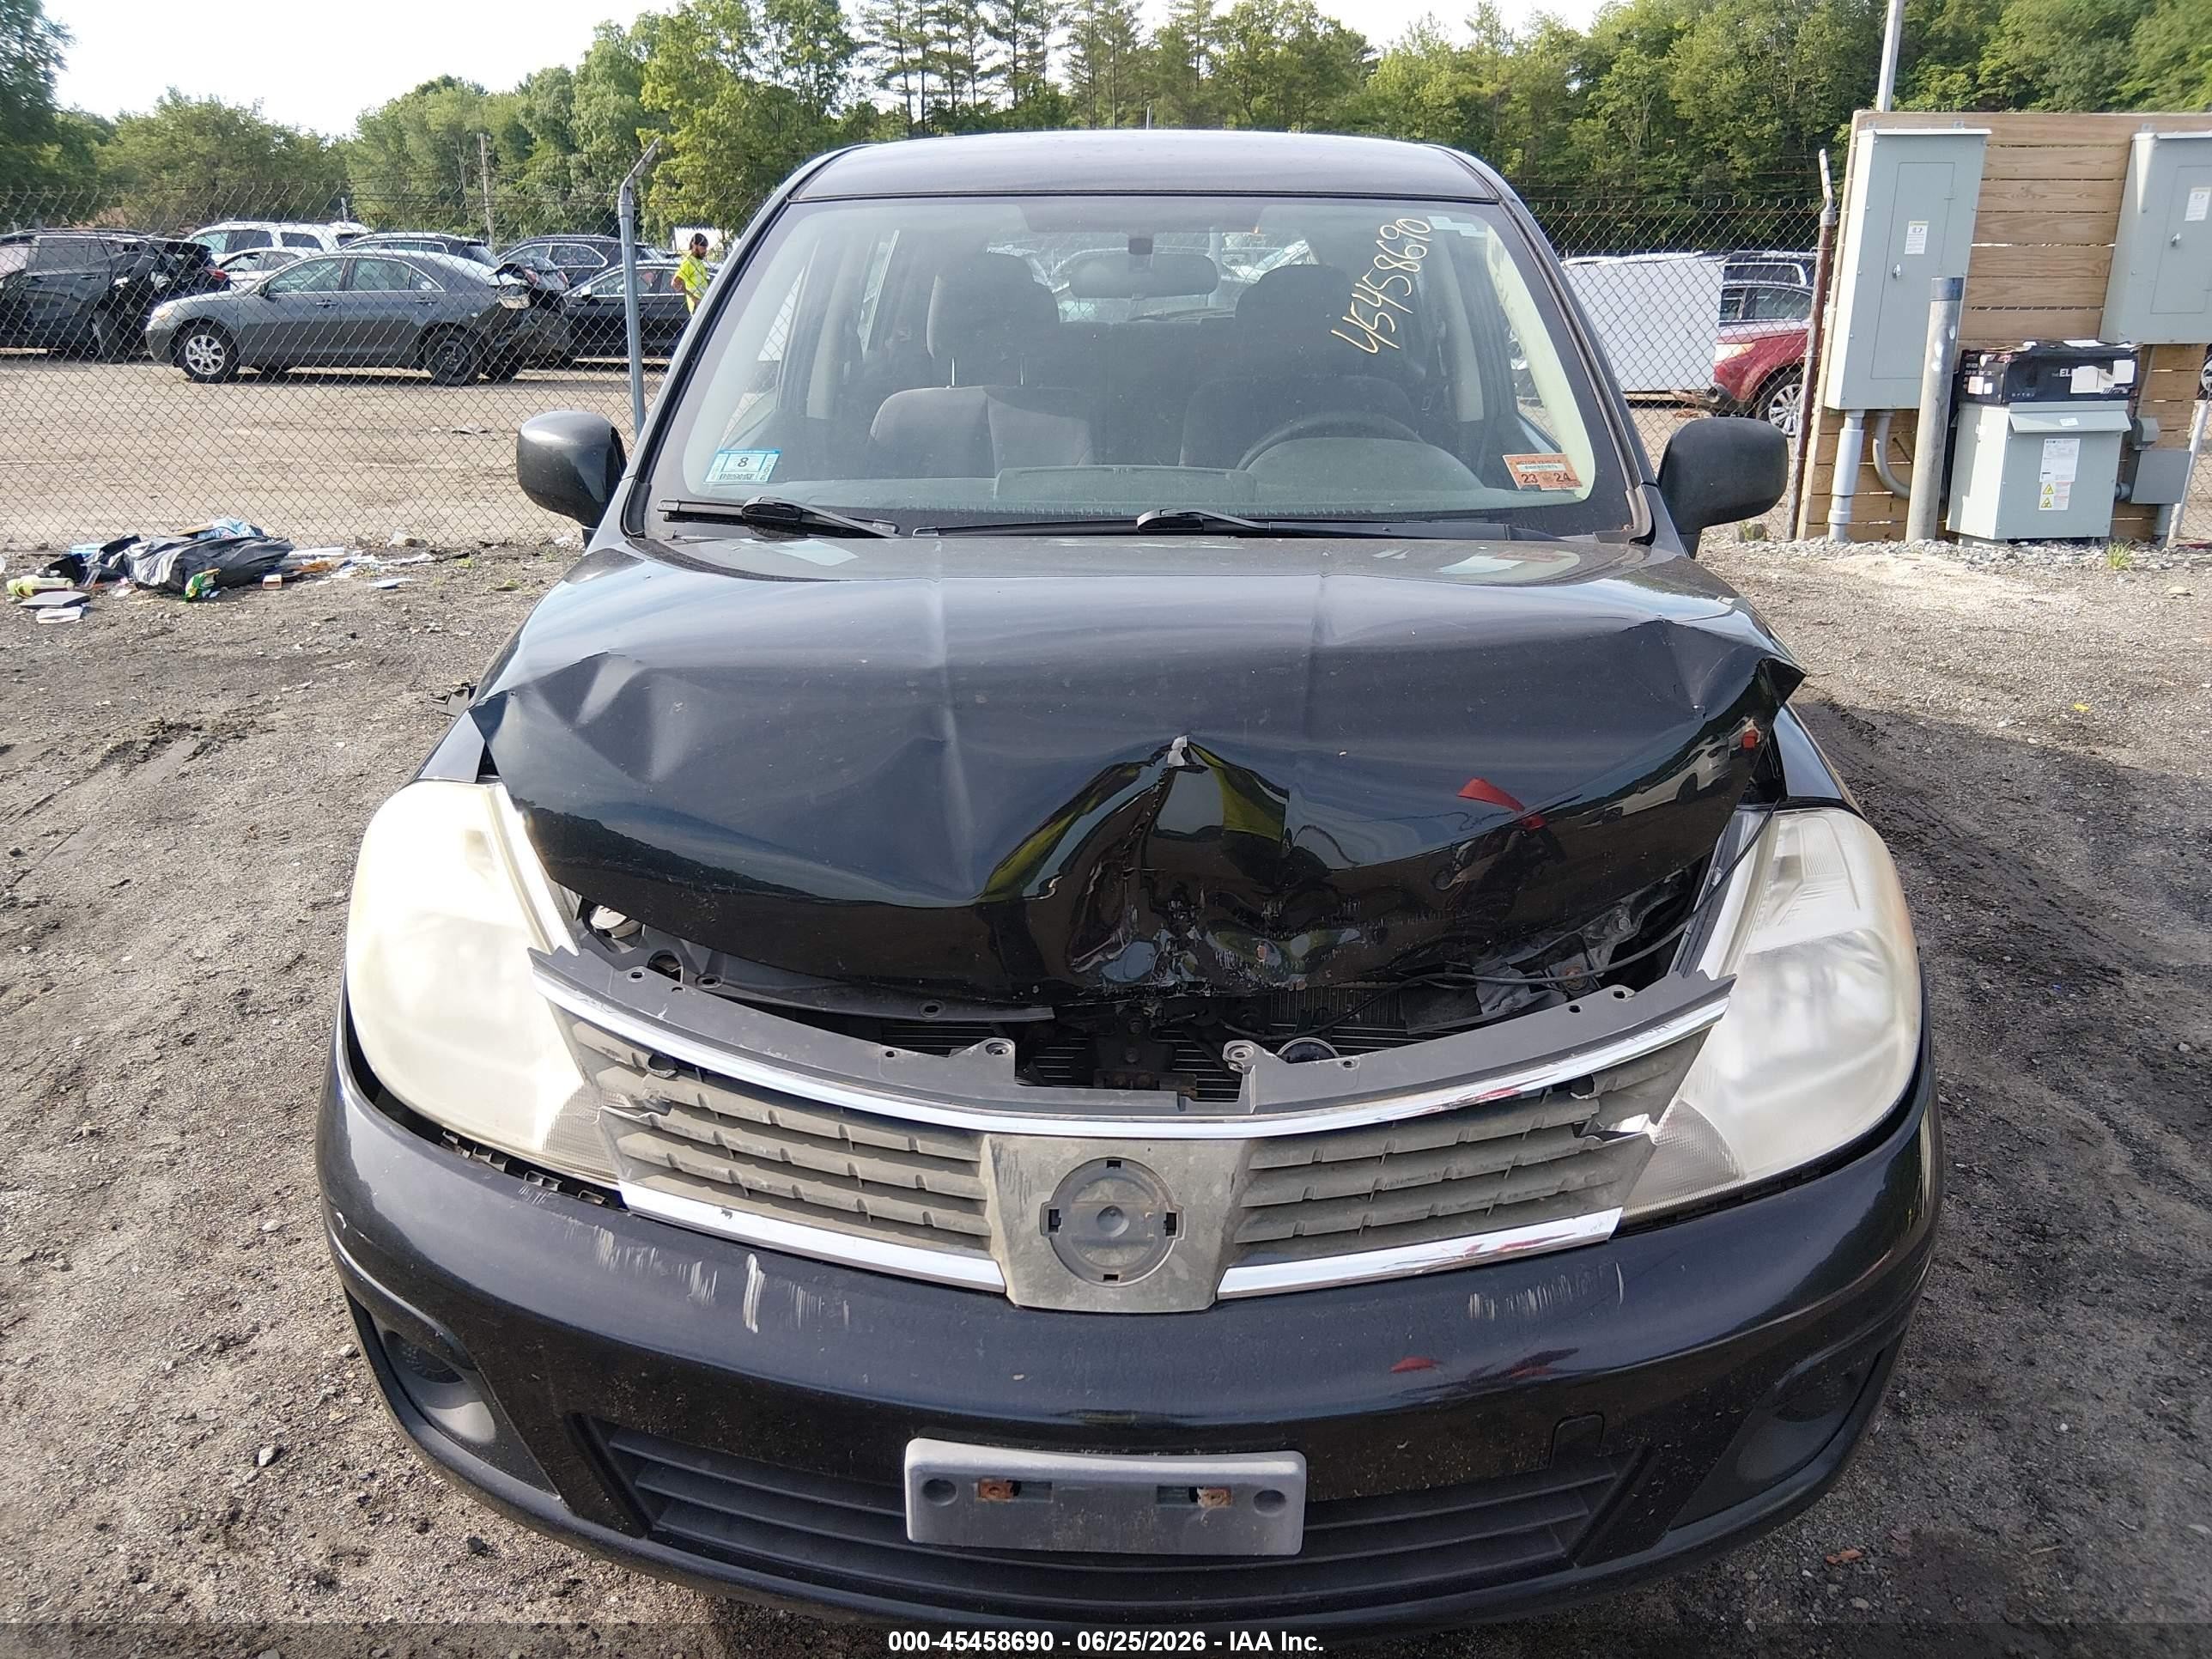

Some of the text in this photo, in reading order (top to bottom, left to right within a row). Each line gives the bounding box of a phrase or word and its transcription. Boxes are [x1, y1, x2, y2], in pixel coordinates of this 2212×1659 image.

[1330, 218, 1433, 355] 45458690
[737, 457, 750, 468] 8
[1521, 472, 1571, 483] 23 24
